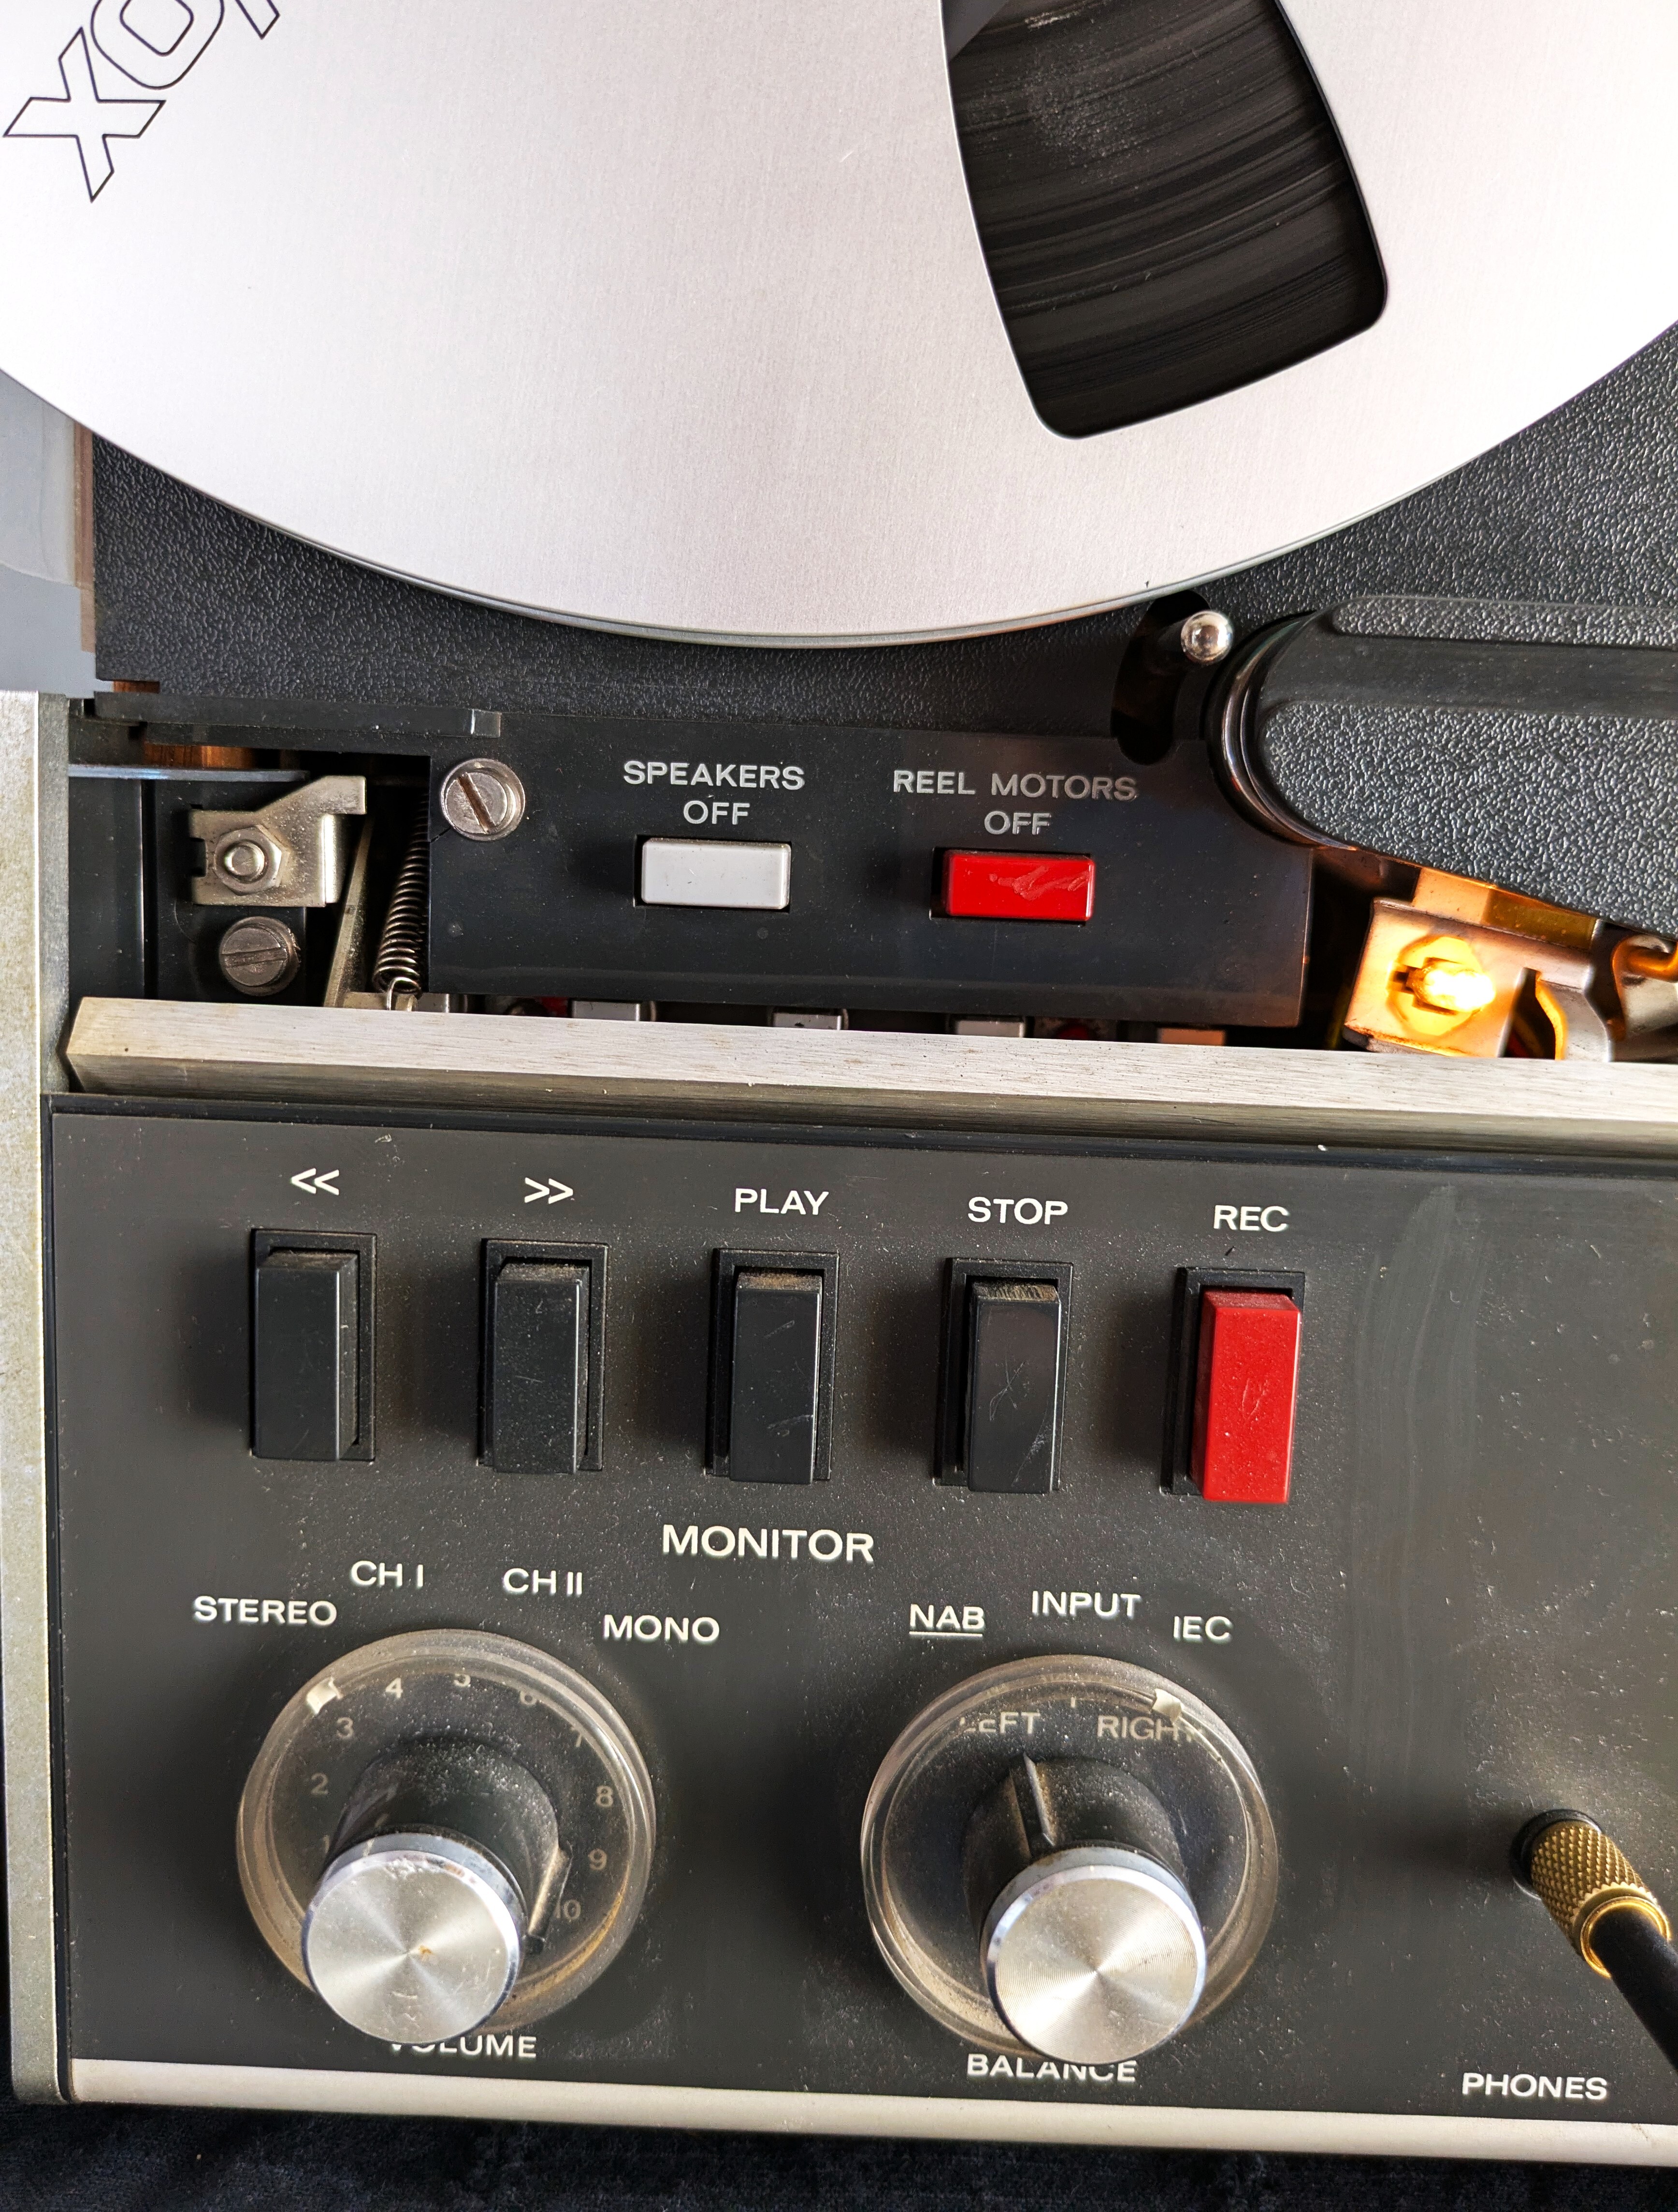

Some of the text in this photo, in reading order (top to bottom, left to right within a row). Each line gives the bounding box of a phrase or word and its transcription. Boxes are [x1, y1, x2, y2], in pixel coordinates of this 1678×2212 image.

[623, 760, 806, 791] SPEAKERS
[893, 769, 1138, 801] REEL MOTORS
[682, 800, 751, 825] OFF
[984, 810, 1051, 835] OFF
[733, 1187, 830, 1216] PLAY
[967, 1196, 1069, 1225] STOP
[1213, 1204, 1289, 1233] REC
[662, 1523, 874, 1564] MONITOR
[350, 1560, 424, 1589] CH I
[502, 1567, 583, 1597] CH II
[193, 1595, 337, 1627] STEREO
[908, 1603, 985, 1632] NAB
[1031, 1590, 1142, 1620] INPUT
[603, 1614, 720, 1643] MONO
[1172, 1615, 1233, 1642] IEC
[386, 1677, 404, 1698] 4
[337, 1716, 354, 1738] 3
[310, 1772, 330, 1795] 2
[595, 1785, 614, 1808] 8
[587, 1848, 608, 1871] 9
[1461, 2072, 1608, 2101] PHONES
